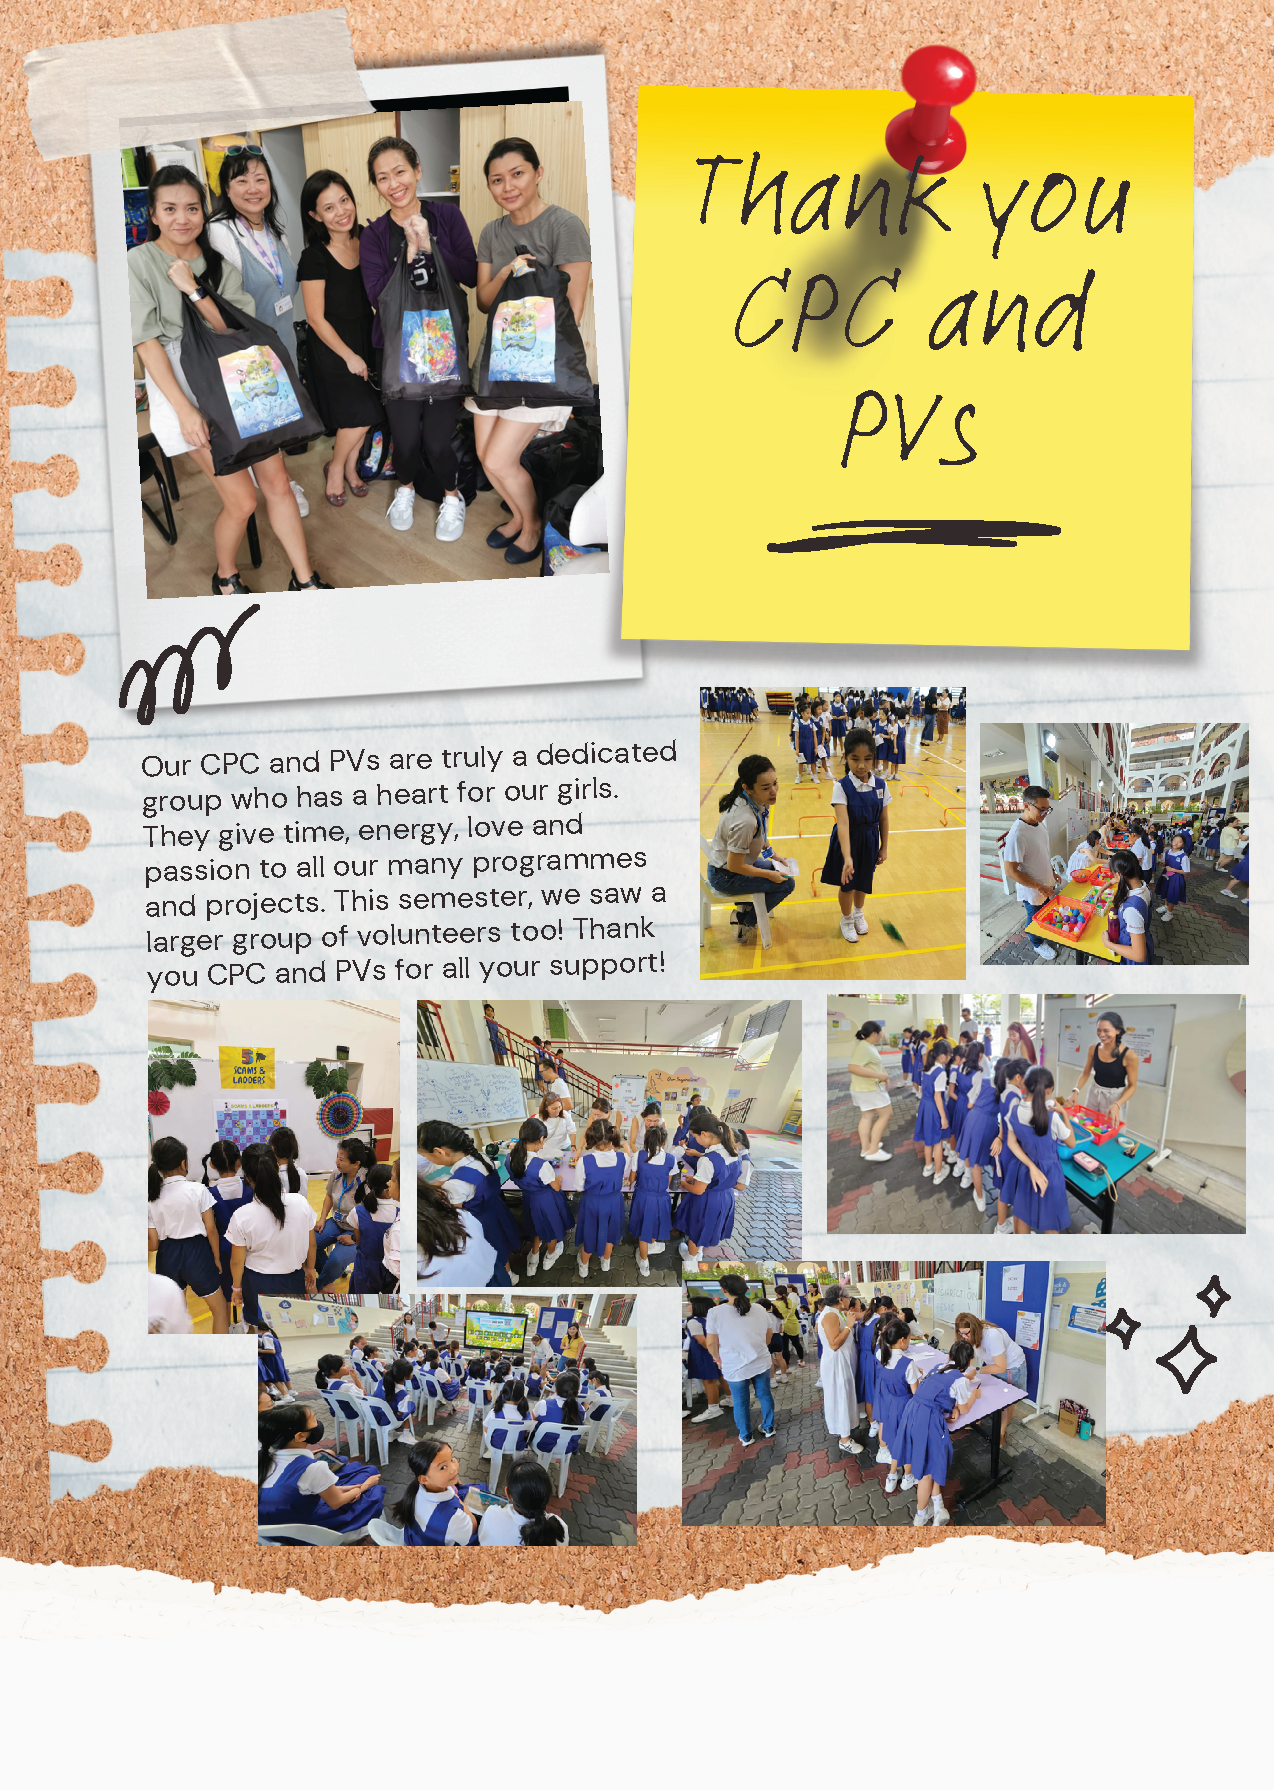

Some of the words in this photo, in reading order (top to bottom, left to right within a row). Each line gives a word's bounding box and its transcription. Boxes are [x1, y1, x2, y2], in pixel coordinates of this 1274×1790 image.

[234, 1066, 257, 1075] SCAMS
[259, 1067, 266, 1075] &
[232, 1076, 266, 1085] LADDERS
